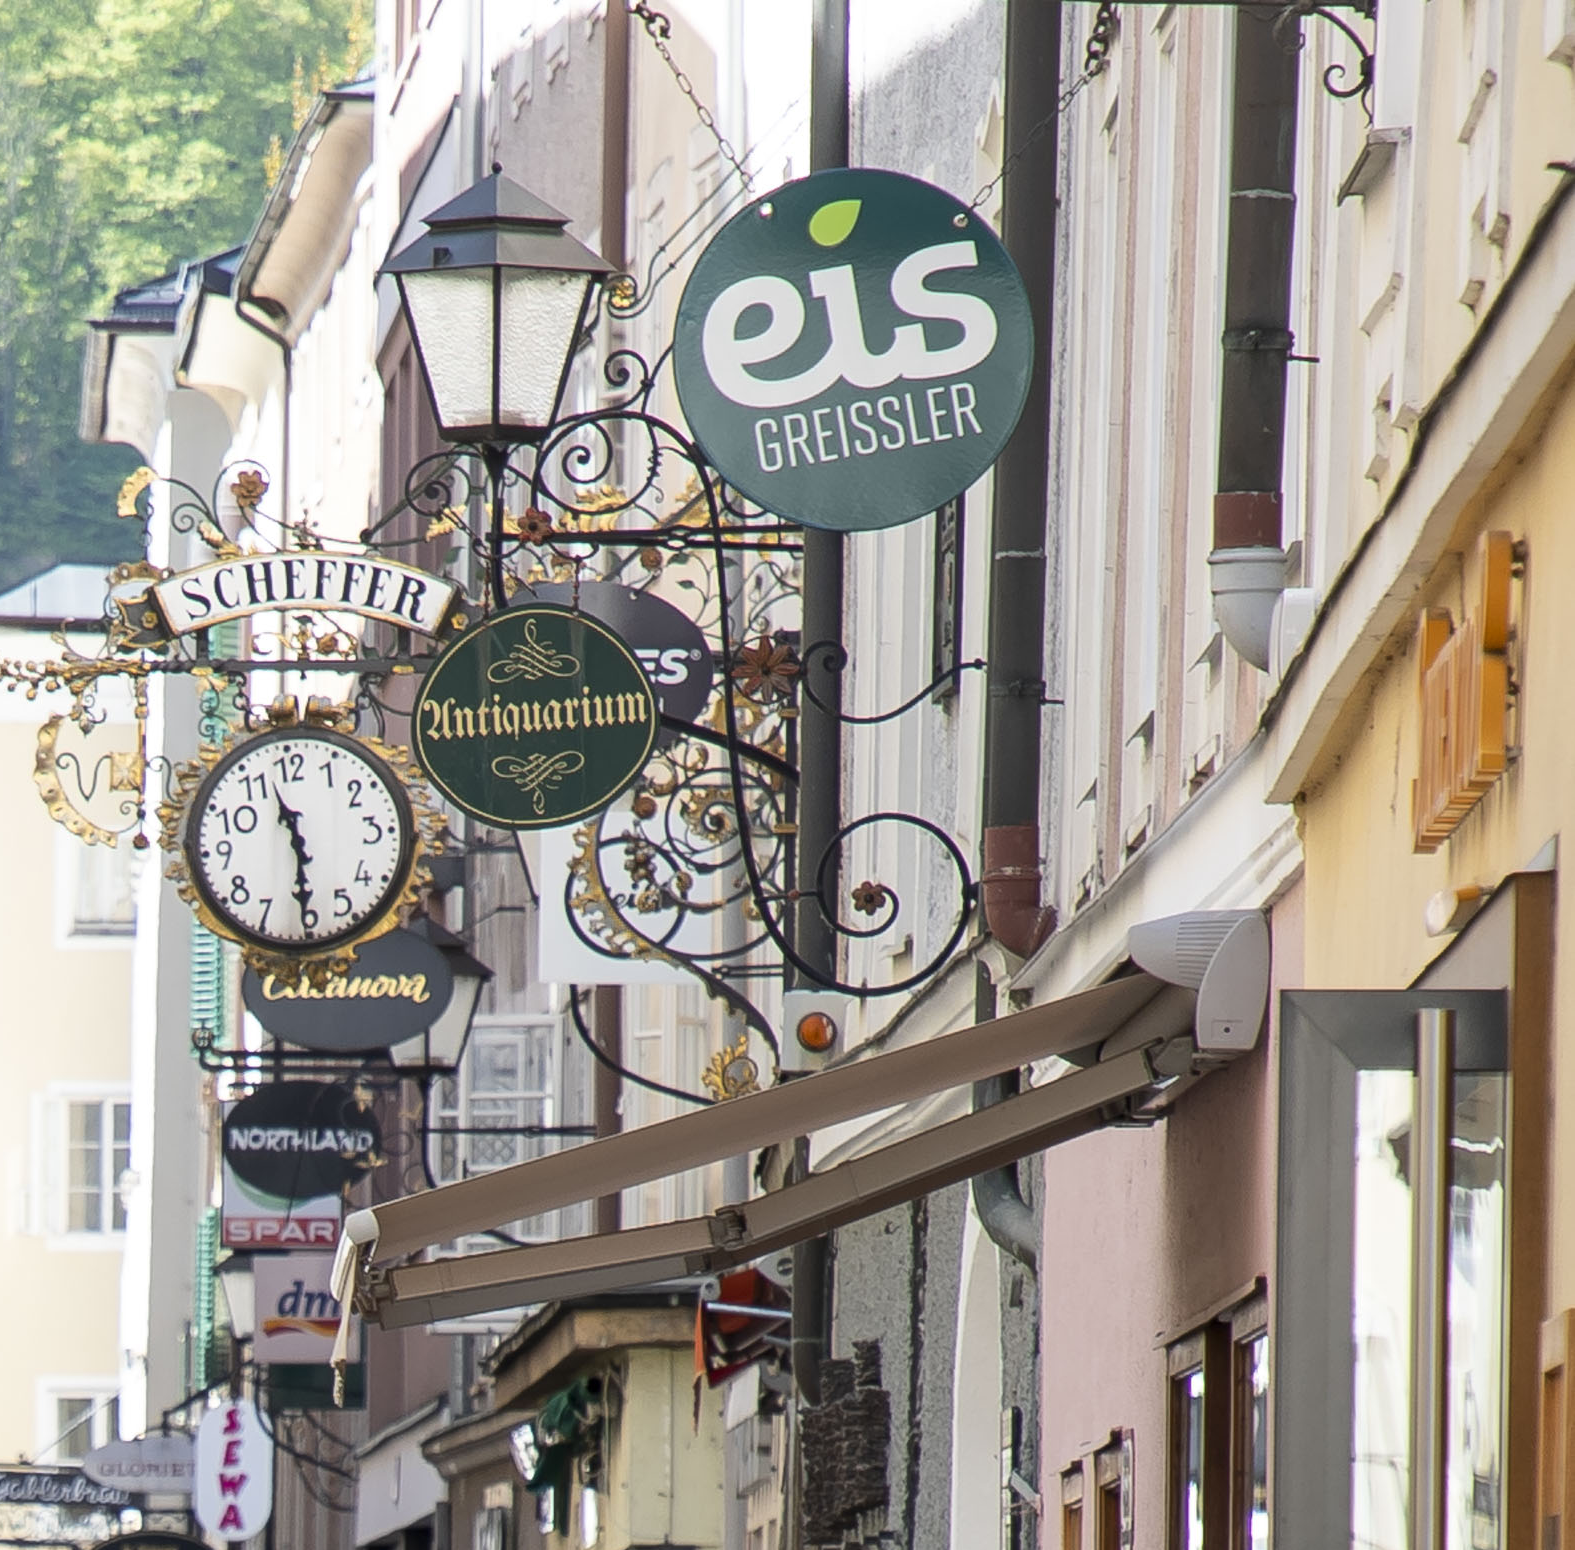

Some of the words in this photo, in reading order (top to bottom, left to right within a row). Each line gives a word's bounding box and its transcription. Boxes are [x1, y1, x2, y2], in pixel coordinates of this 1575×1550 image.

[702, 200, 998, 408] eis
[754, 382, 983, 473] GREISSLER
[179, 555, 429, 627] SCHEFFER
[422, 684, 650, 742] Antiquarium
[272, 753, 305, 784] 12
[318, 761, 334, 789] 1
[238, 772, 269, 802] 11
[347, 779, 363, 809] 2
[215, 804, 258, 835] 10
[362, 815, 383, 845] 3
[215, 840, 233, 871] 9
[353, 859, 373, 887] 4
[230, 874, 250, 905] 8
[333, 888, 353, 918] 5
[258, 898, 274, 929] 7
[229, 1127, 375, 1153] NORTHLAND
[226, 1221, 336, 1243] SPAR
[277, 1280, 342, 1318] dm
[218, 1407, 249, 1533] SEWA
